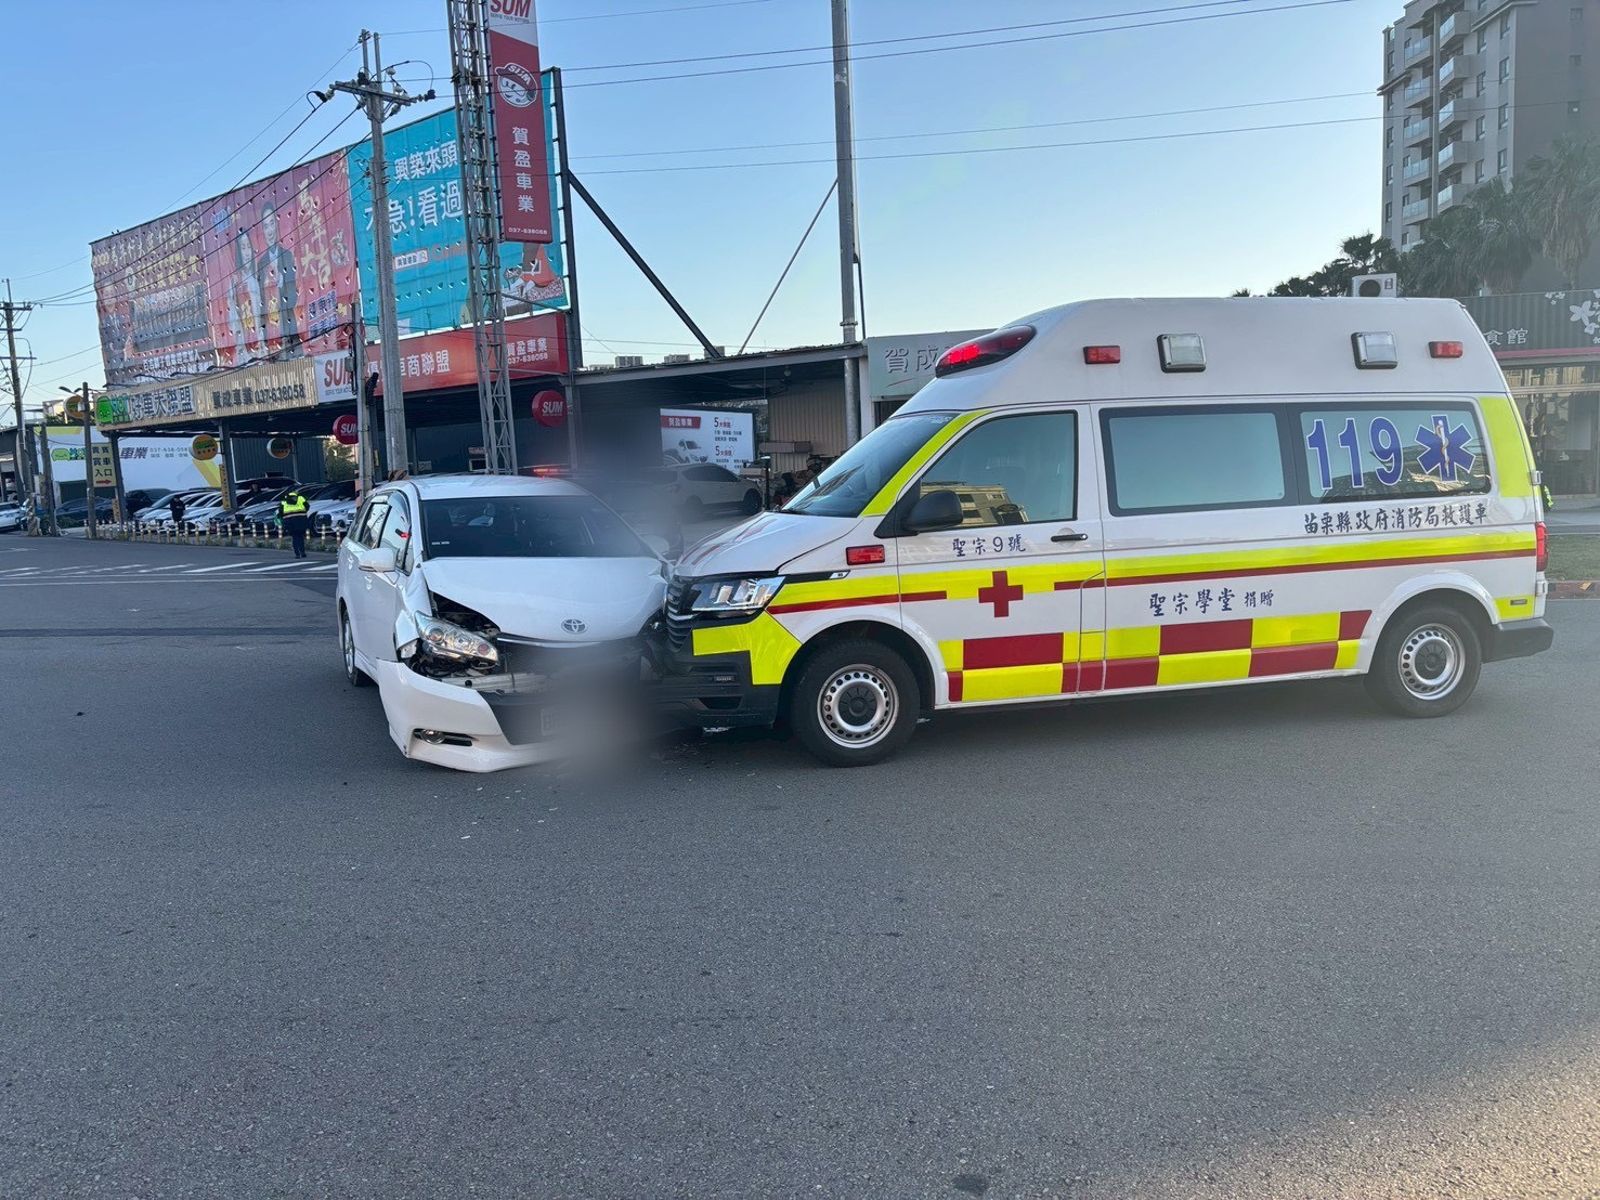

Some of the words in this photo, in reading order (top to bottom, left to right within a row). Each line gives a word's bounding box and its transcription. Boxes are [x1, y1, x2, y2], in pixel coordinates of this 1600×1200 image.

[508, 64, 532, 85] SUM
[512, 126, 535, 213] 賀盈車業
[541, 400, 563, 414] SUM
[1306, 416, 1404, 490] 119
[95, 468, 113, 477] 入口
[1304, 502, 1488, 536] 苗栗縣政府消防局救護車
[952, 533, 1026, 558] 聖宗9號
